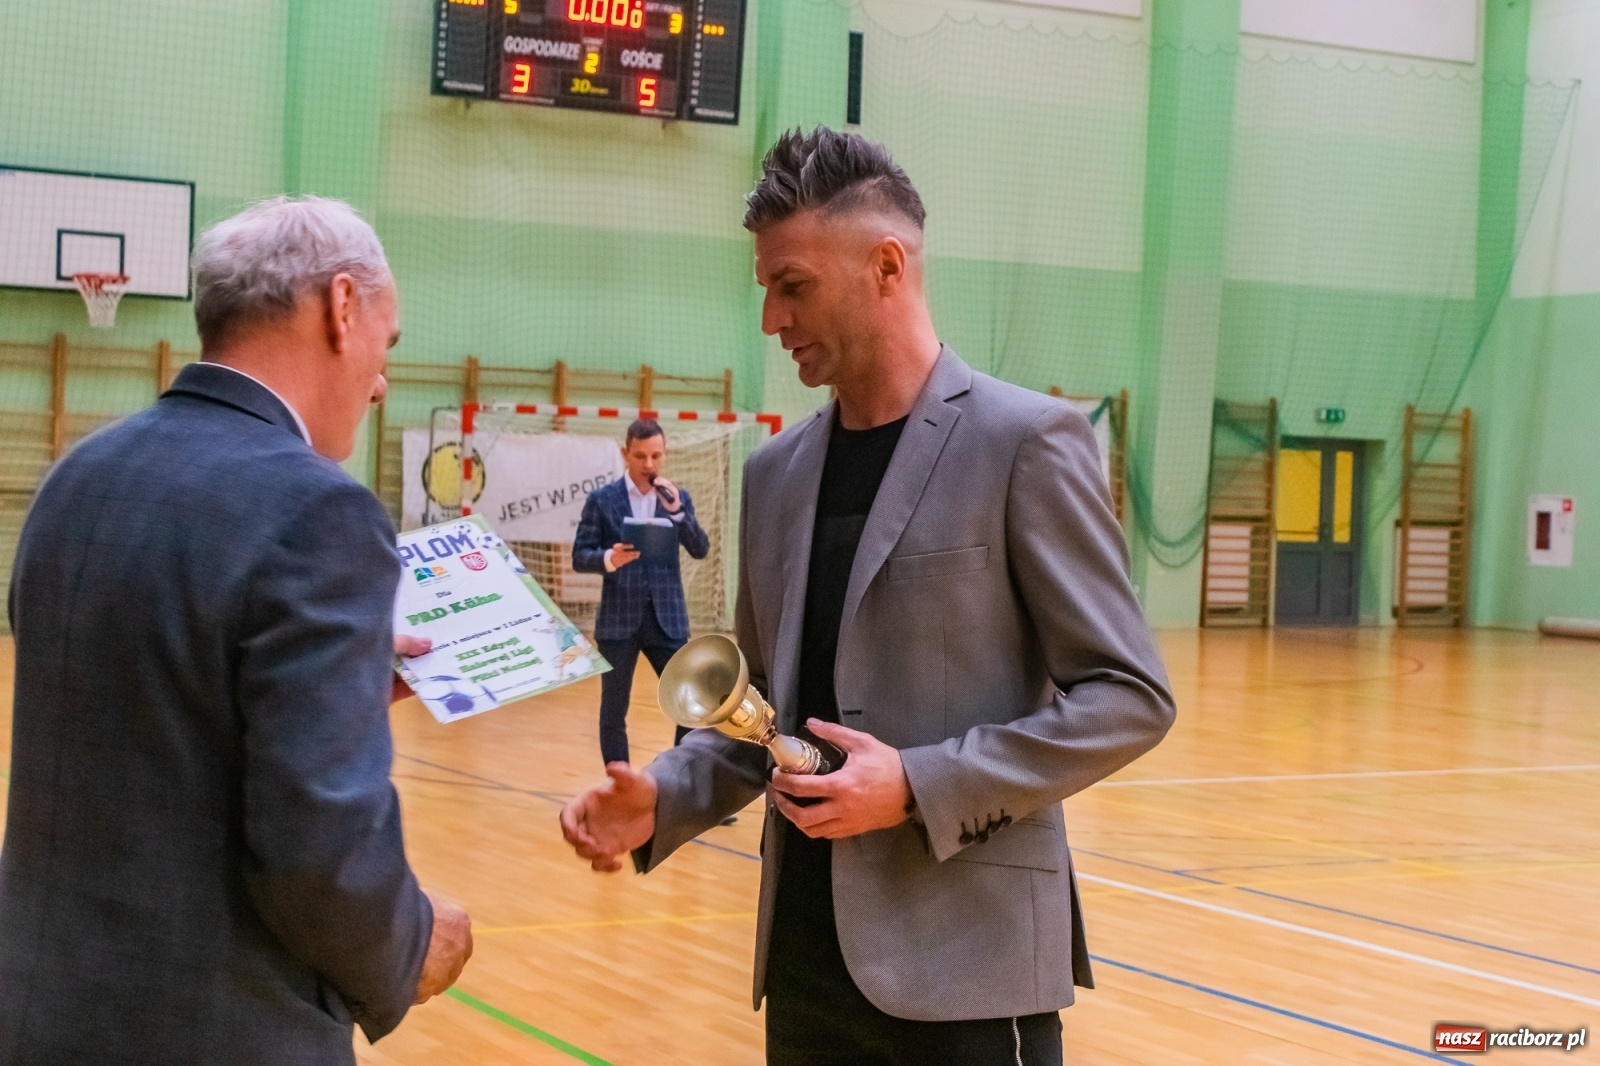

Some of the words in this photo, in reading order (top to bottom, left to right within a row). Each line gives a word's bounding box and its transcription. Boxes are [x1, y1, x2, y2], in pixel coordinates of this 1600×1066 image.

[669, 13, 683, 34] 3
[503, 35, 581, 61] GOSPODARZE
[620, 47, 664, 70] GOŚCIE
[584, 52, 599, 74] 2
[512, 63, 531, 94] 3
[639, 78, 656, 107] 5
[499, 494, 541, 521] JEST
[547, 488, 565, 505] W
